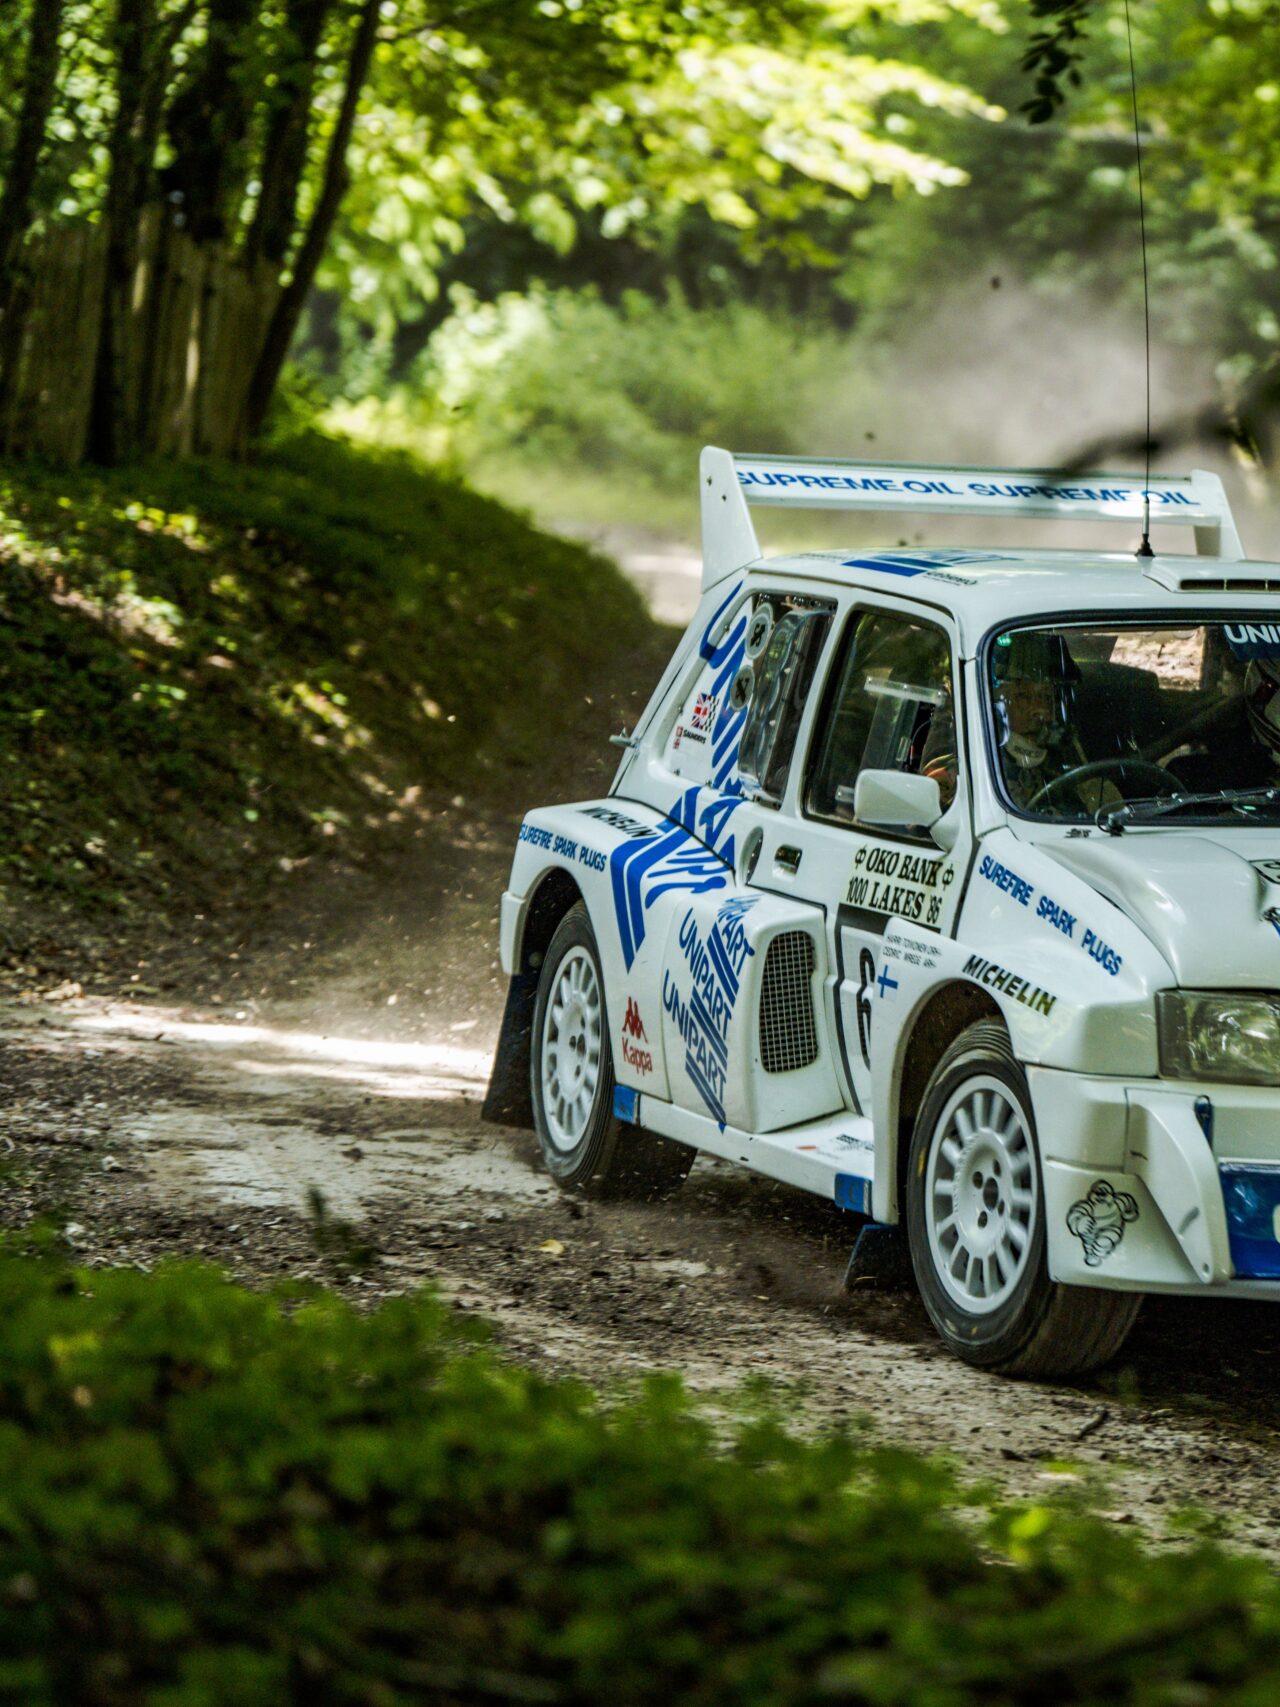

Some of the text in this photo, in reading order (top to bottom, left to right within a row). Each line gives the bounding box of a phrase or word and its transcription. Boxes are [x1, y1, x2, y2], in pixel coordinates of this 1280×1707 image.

[736, 472, 964, 495] SUPREME OIL
[967, 483, 1200, 506] SUPREME OIL
[519, 823, 607, 872] SUREFIRE SPARK PLUGS
[866, 848, 943, 888] OKO BANK
[847, 877, 868, 903] 1000
[869, 881, 926, 919] LAKES
[979, 855, 1122, 976] SUREFIRE SPARK PLUGS
[679, 907, 733, 1040] UNIPART
[962, 954, 1057, 1016] MICHELIN
[621, 1036, 653, 1077] Kappa
[663, 969, 728, 1104] UNIPART
